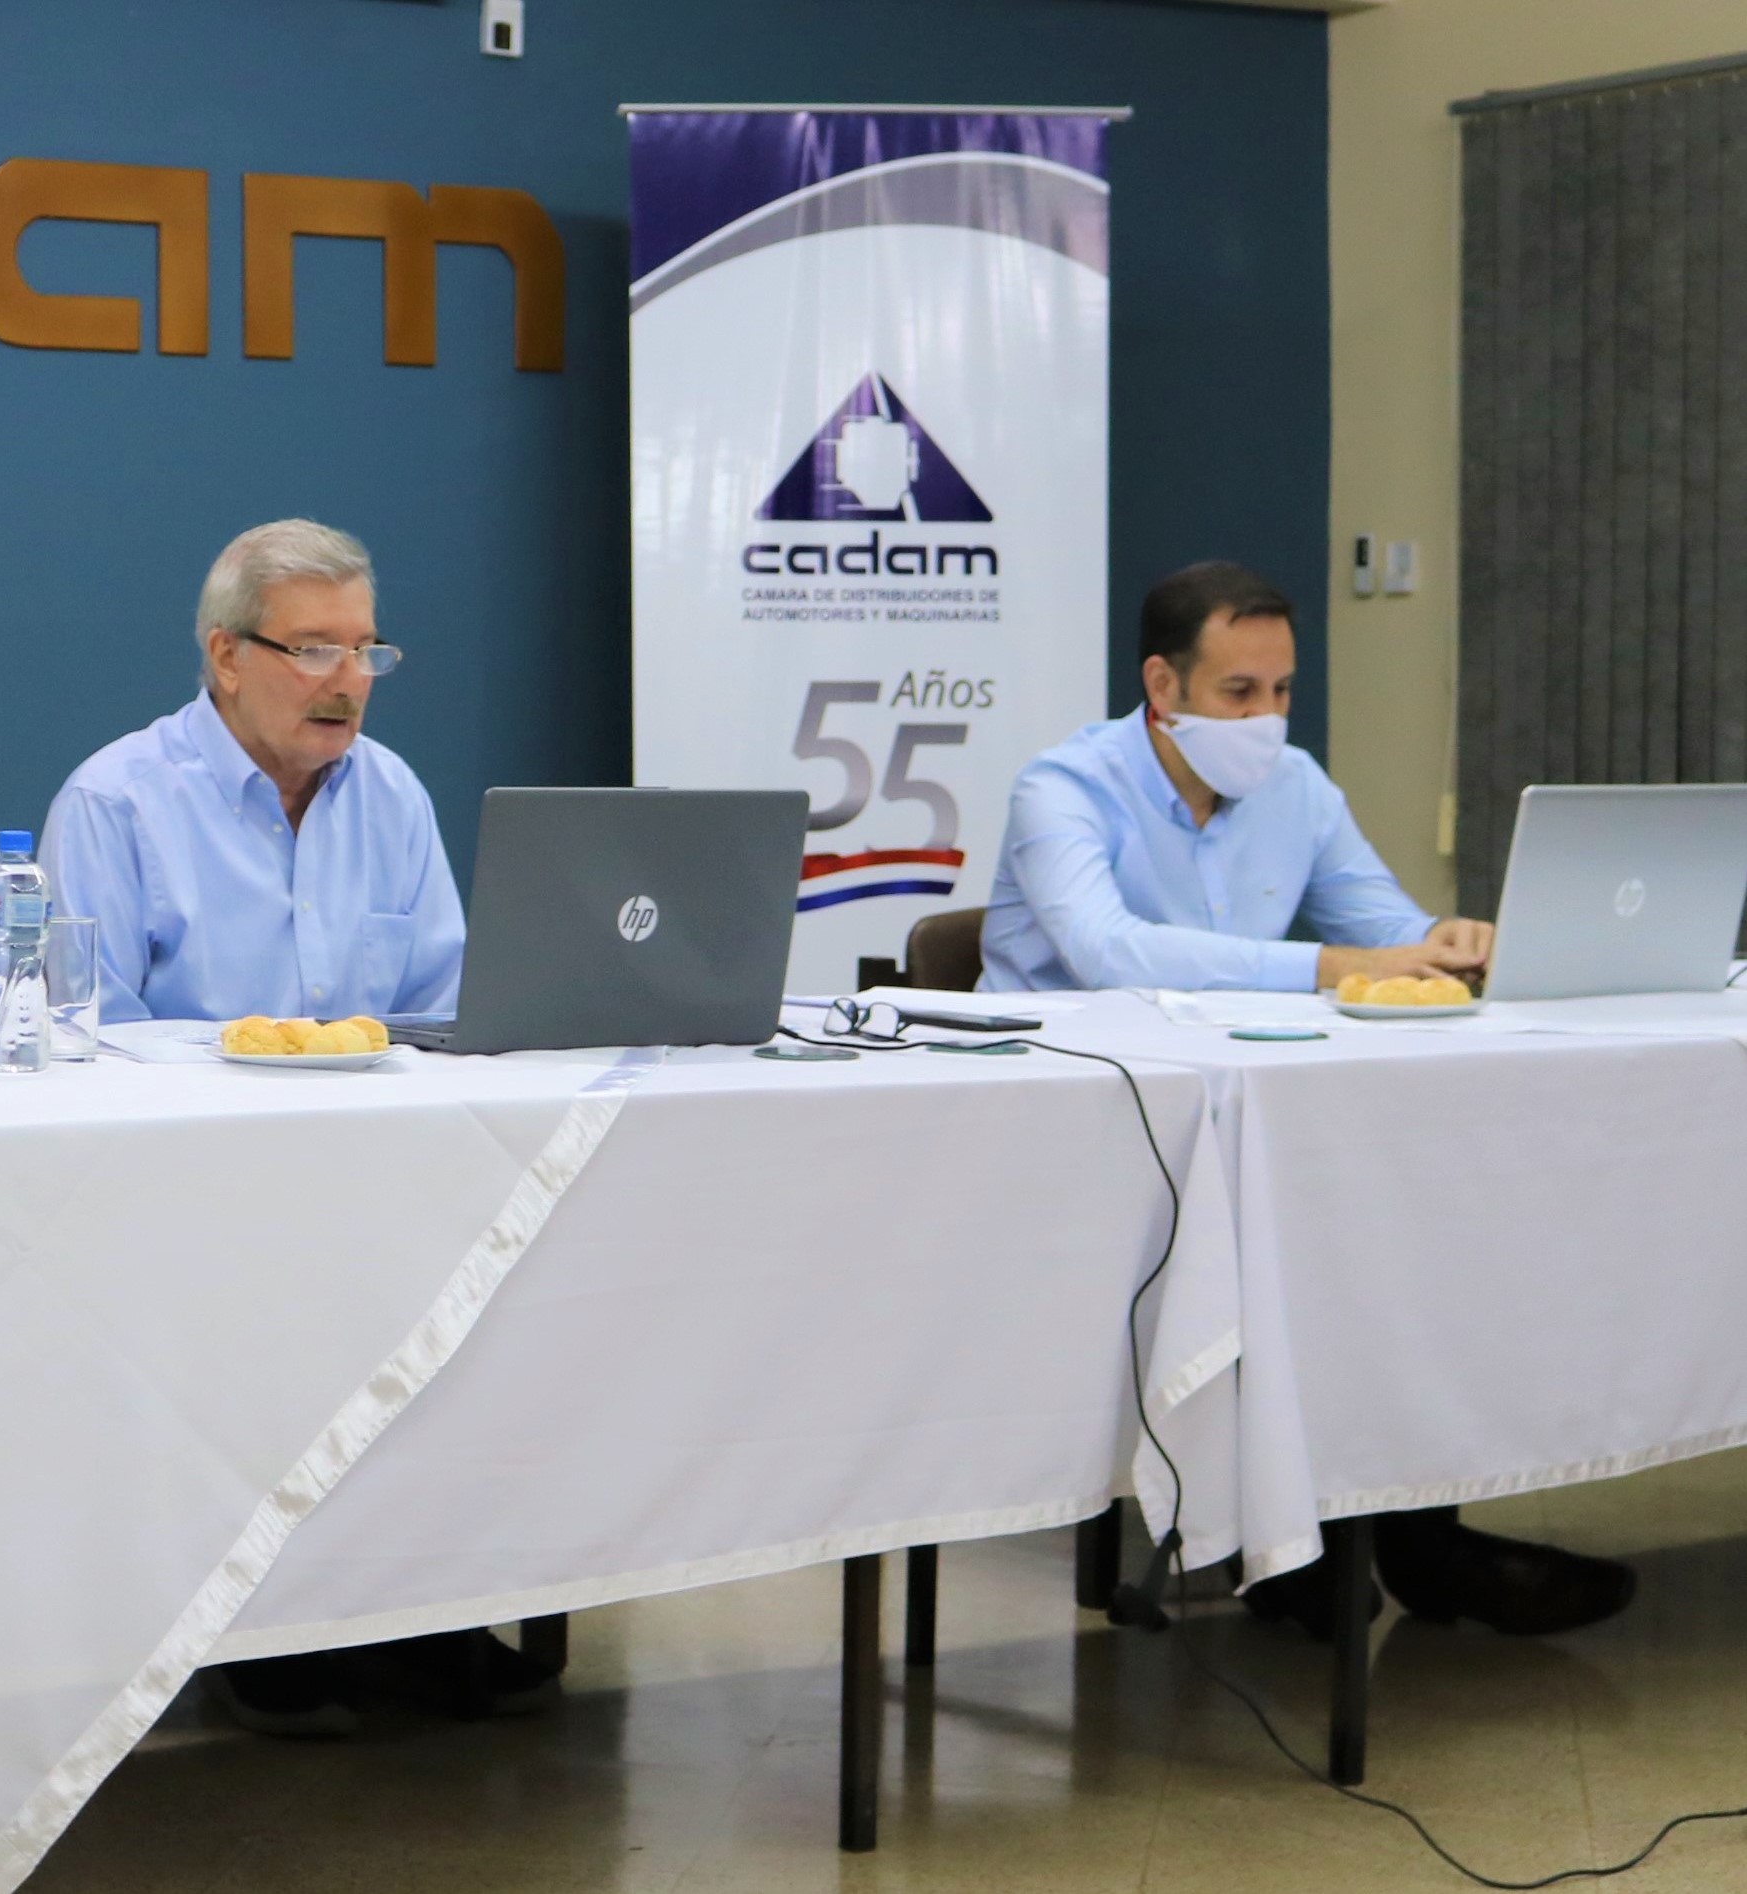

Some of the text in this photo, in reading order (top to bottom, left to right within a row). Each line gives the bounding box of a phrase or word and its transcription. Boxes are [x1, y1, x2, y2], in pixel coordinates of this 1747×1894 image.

[742, 530, 998, 575] cadam
[742, 588, 999, 603] CAMARA DE DISTRIBUIDORES DE
[742, 607, 1000, 622] AUTOMOTORES Y MAQUINARIAS
[889, 669, 996, 709] Años
[792, 680, 969, 851] 55
[622, 896, 654, 941] hp
